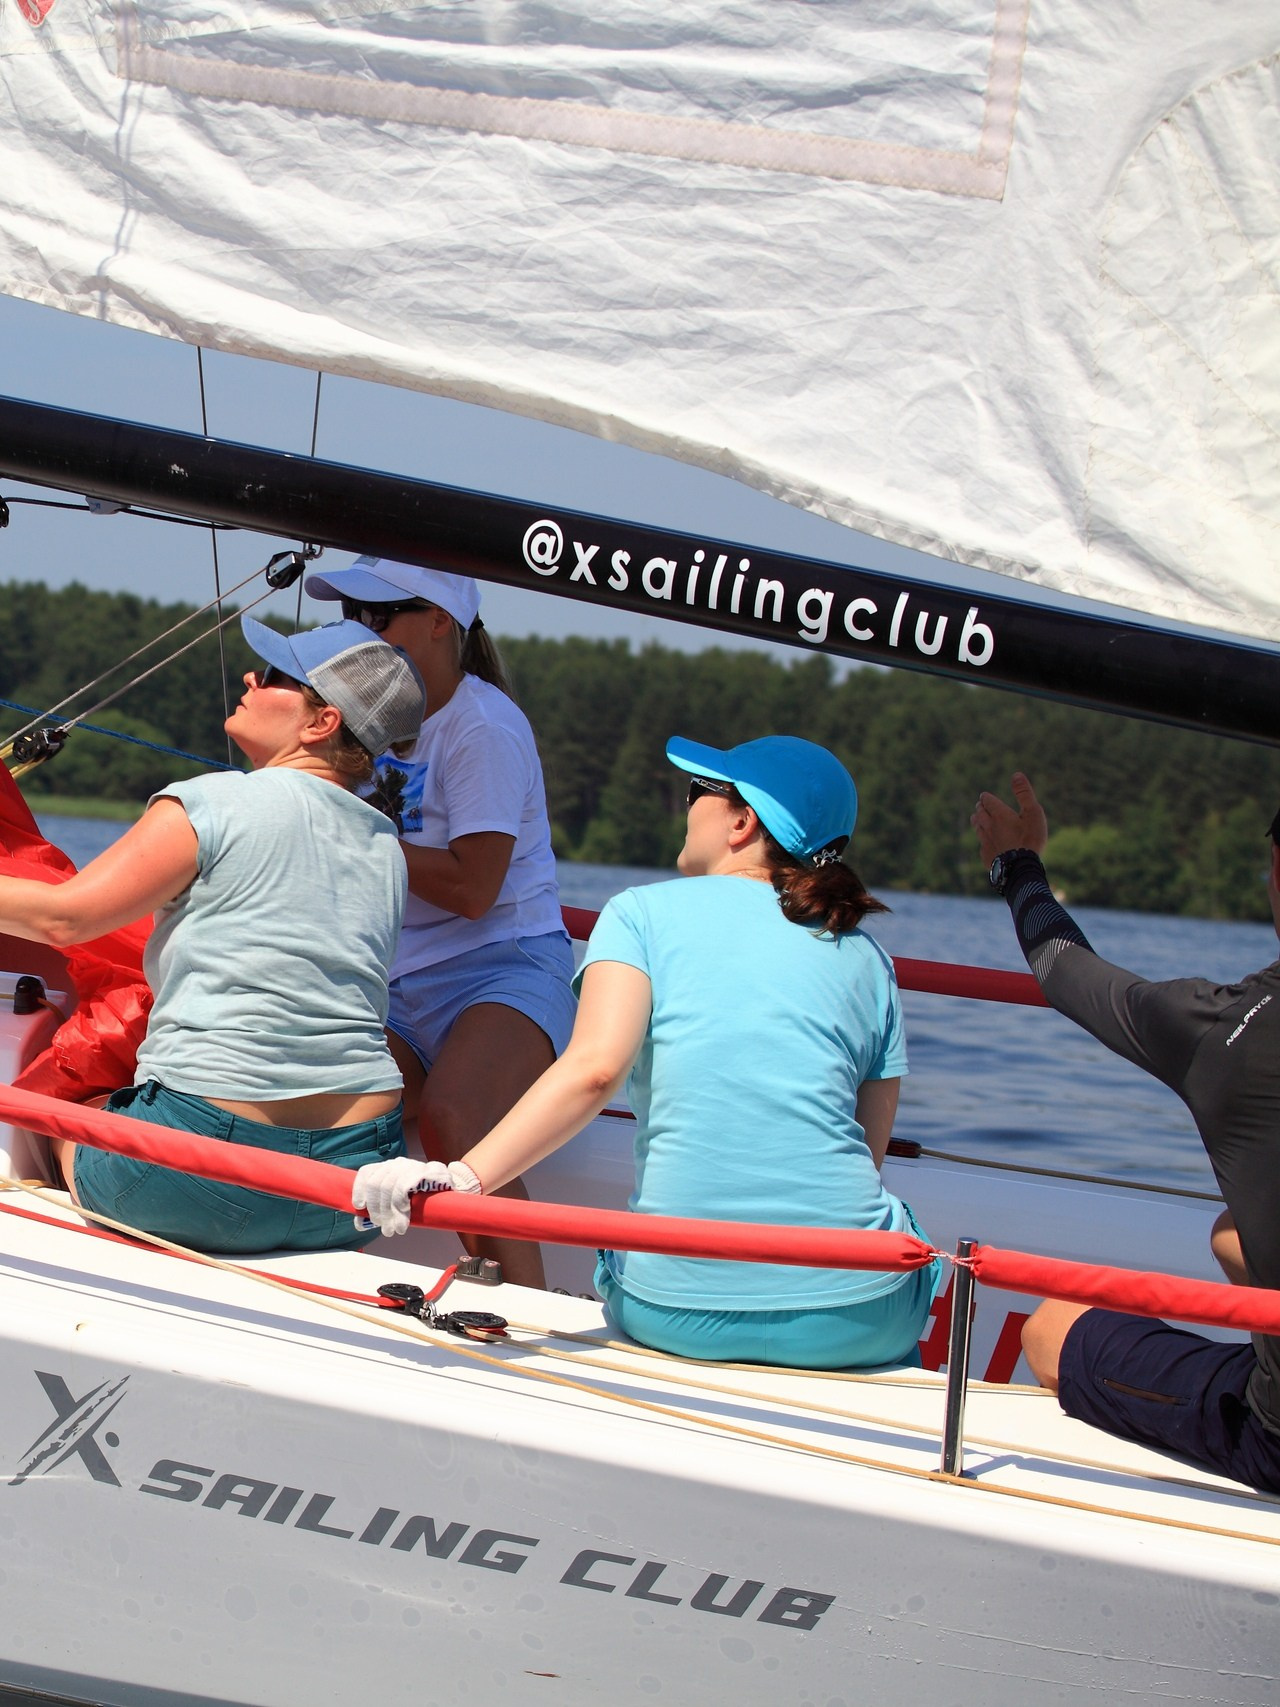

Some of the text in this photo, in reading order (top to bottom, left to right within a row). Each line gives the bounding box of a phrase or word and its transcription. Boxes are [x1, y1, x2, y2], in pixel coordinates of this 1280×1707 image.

[521, 519, 995, 667] @xsailingclub
[1225, 993, 1274, 1047] NEILPRYDE
[138, 1459, 541, 1575] SAILING
[559, 1549, 837, 1632] CLUB
